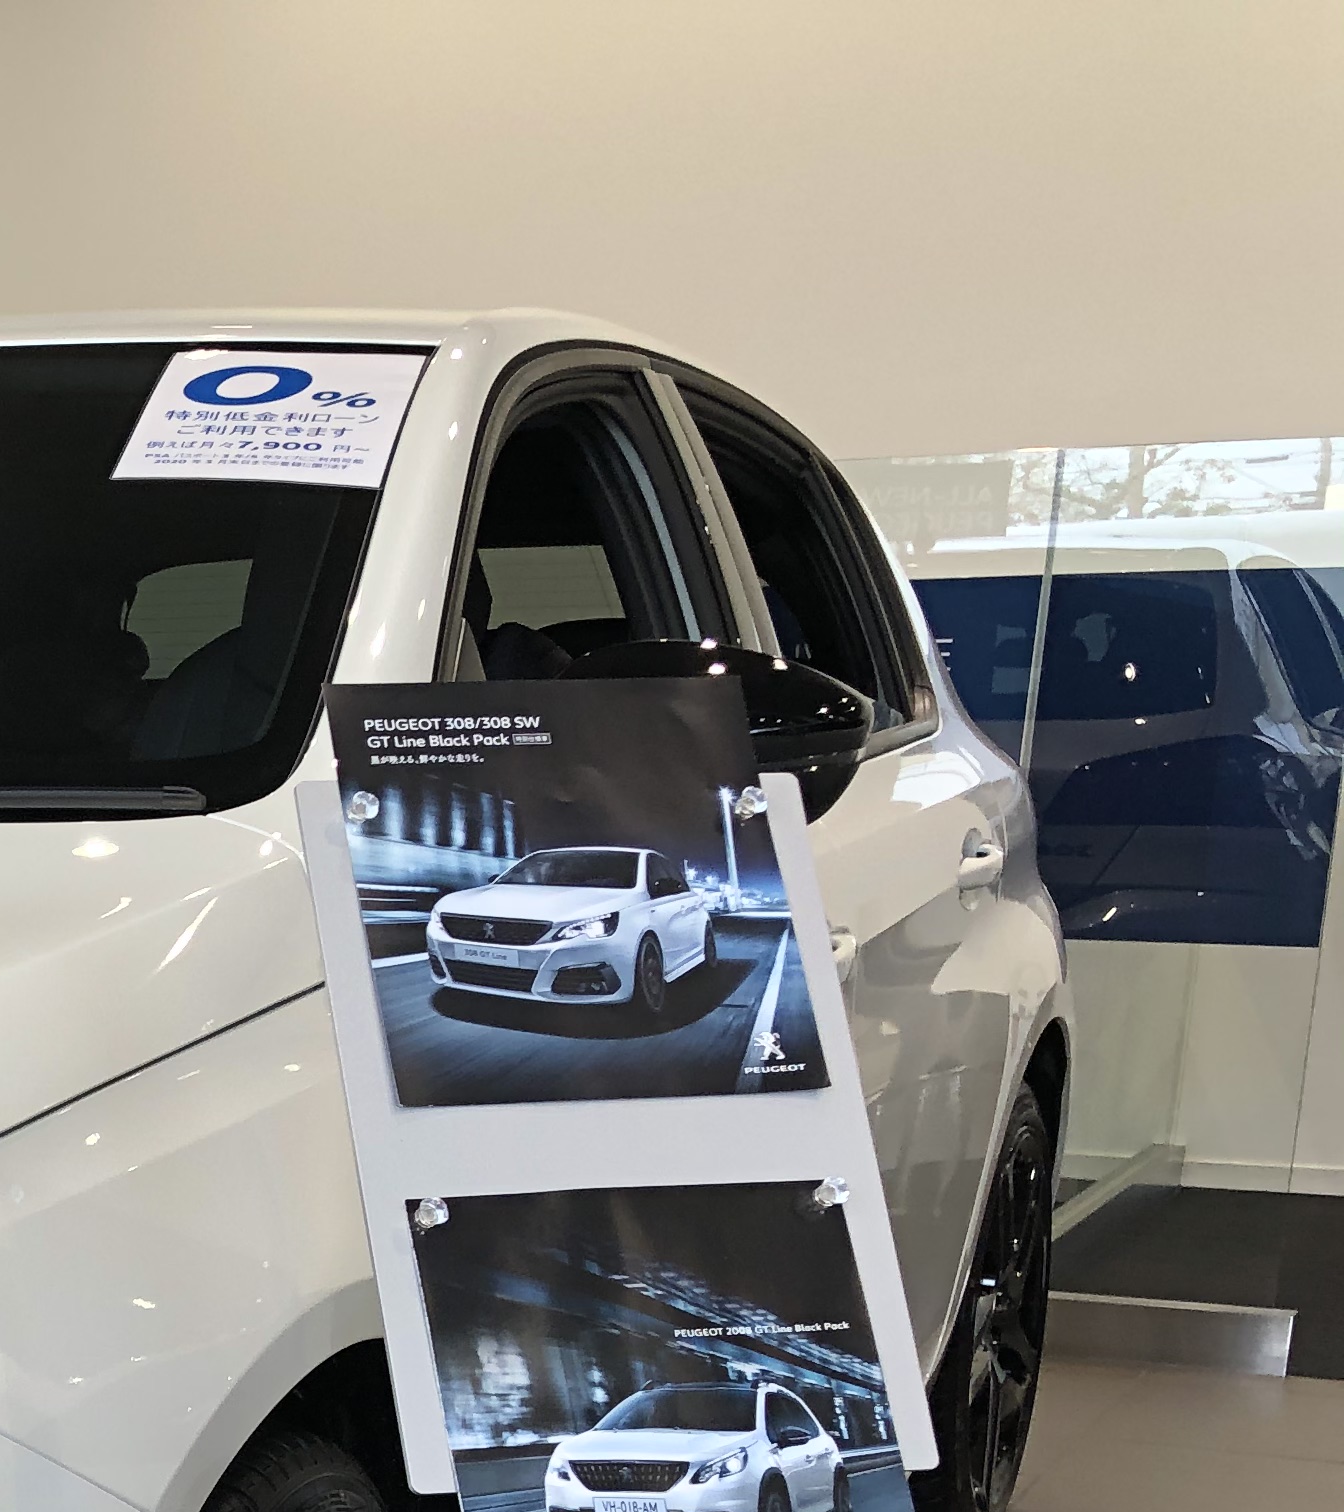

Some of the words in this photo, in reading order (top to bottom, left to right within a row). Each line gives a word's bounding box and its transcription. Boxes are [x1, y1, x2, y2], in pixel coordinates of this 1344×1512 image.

[164, 409, 380, 424] 特別低金利ローン
[177, 424, 355, 438] ご利用できます
[364, 718, 441, 731] PEUGEOT
[444, 717, 511, 730] 308/308
[513, 716, 540, 729] SW
[367, 736, 390, 748] GT
[394, 735, 426, 748] Line
[429, 734, 470, 747] Black
[473, 733, 510, 746] Pack
[744, 1063, 806, 1074] PEUGEOT
[674, 1327, 724, 1338] PEUGEOT
[726, 1326, 753, 1336] 2008
[754, 1326, 770, 1334] GT
[771, 1325, 792, 1334] Line
[794, 1322, 822, 1333] Black
[823, 1321, 850, 1331] Pack
